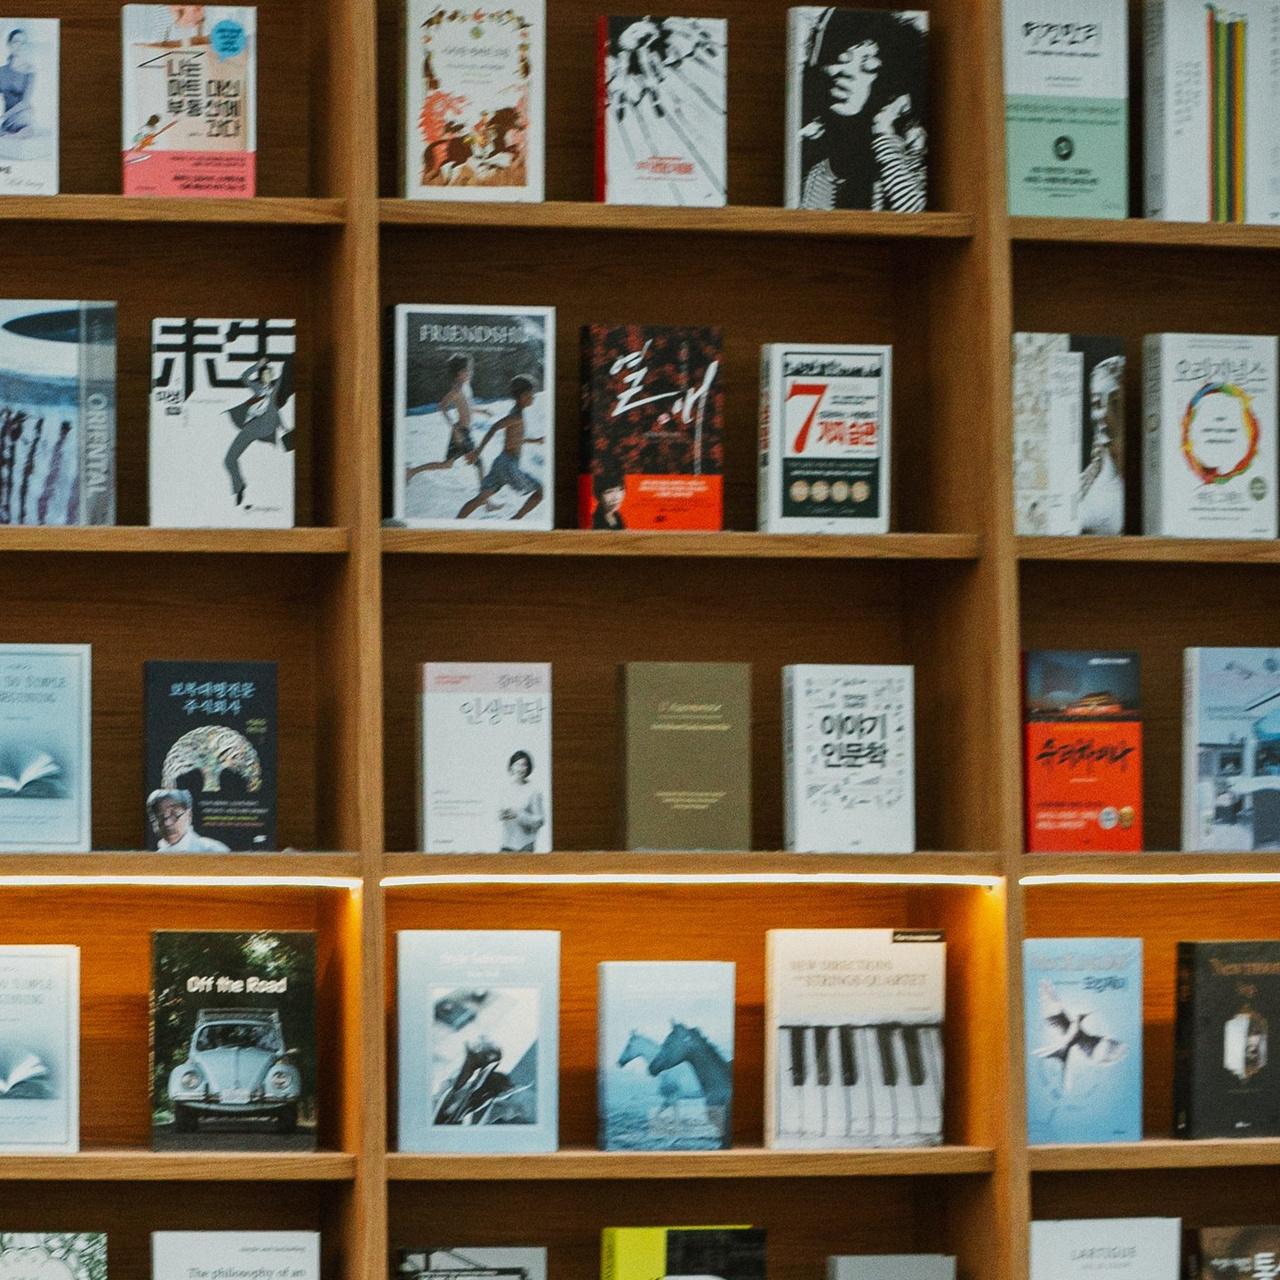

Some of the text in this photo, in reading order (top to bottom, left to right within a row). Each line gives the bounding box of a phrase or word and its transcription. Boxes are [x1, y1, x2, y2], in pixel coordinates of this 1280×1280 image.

[785, 383, 829, 454] 7
[84, 393, 109, 497] ORIENTAL
[819, 712, 889, 740] 이야기
[821, 742, 889, 768] 인문학
[186, 975, 288, 993] Off the Road
[188, 1266, 210, 1278] The
